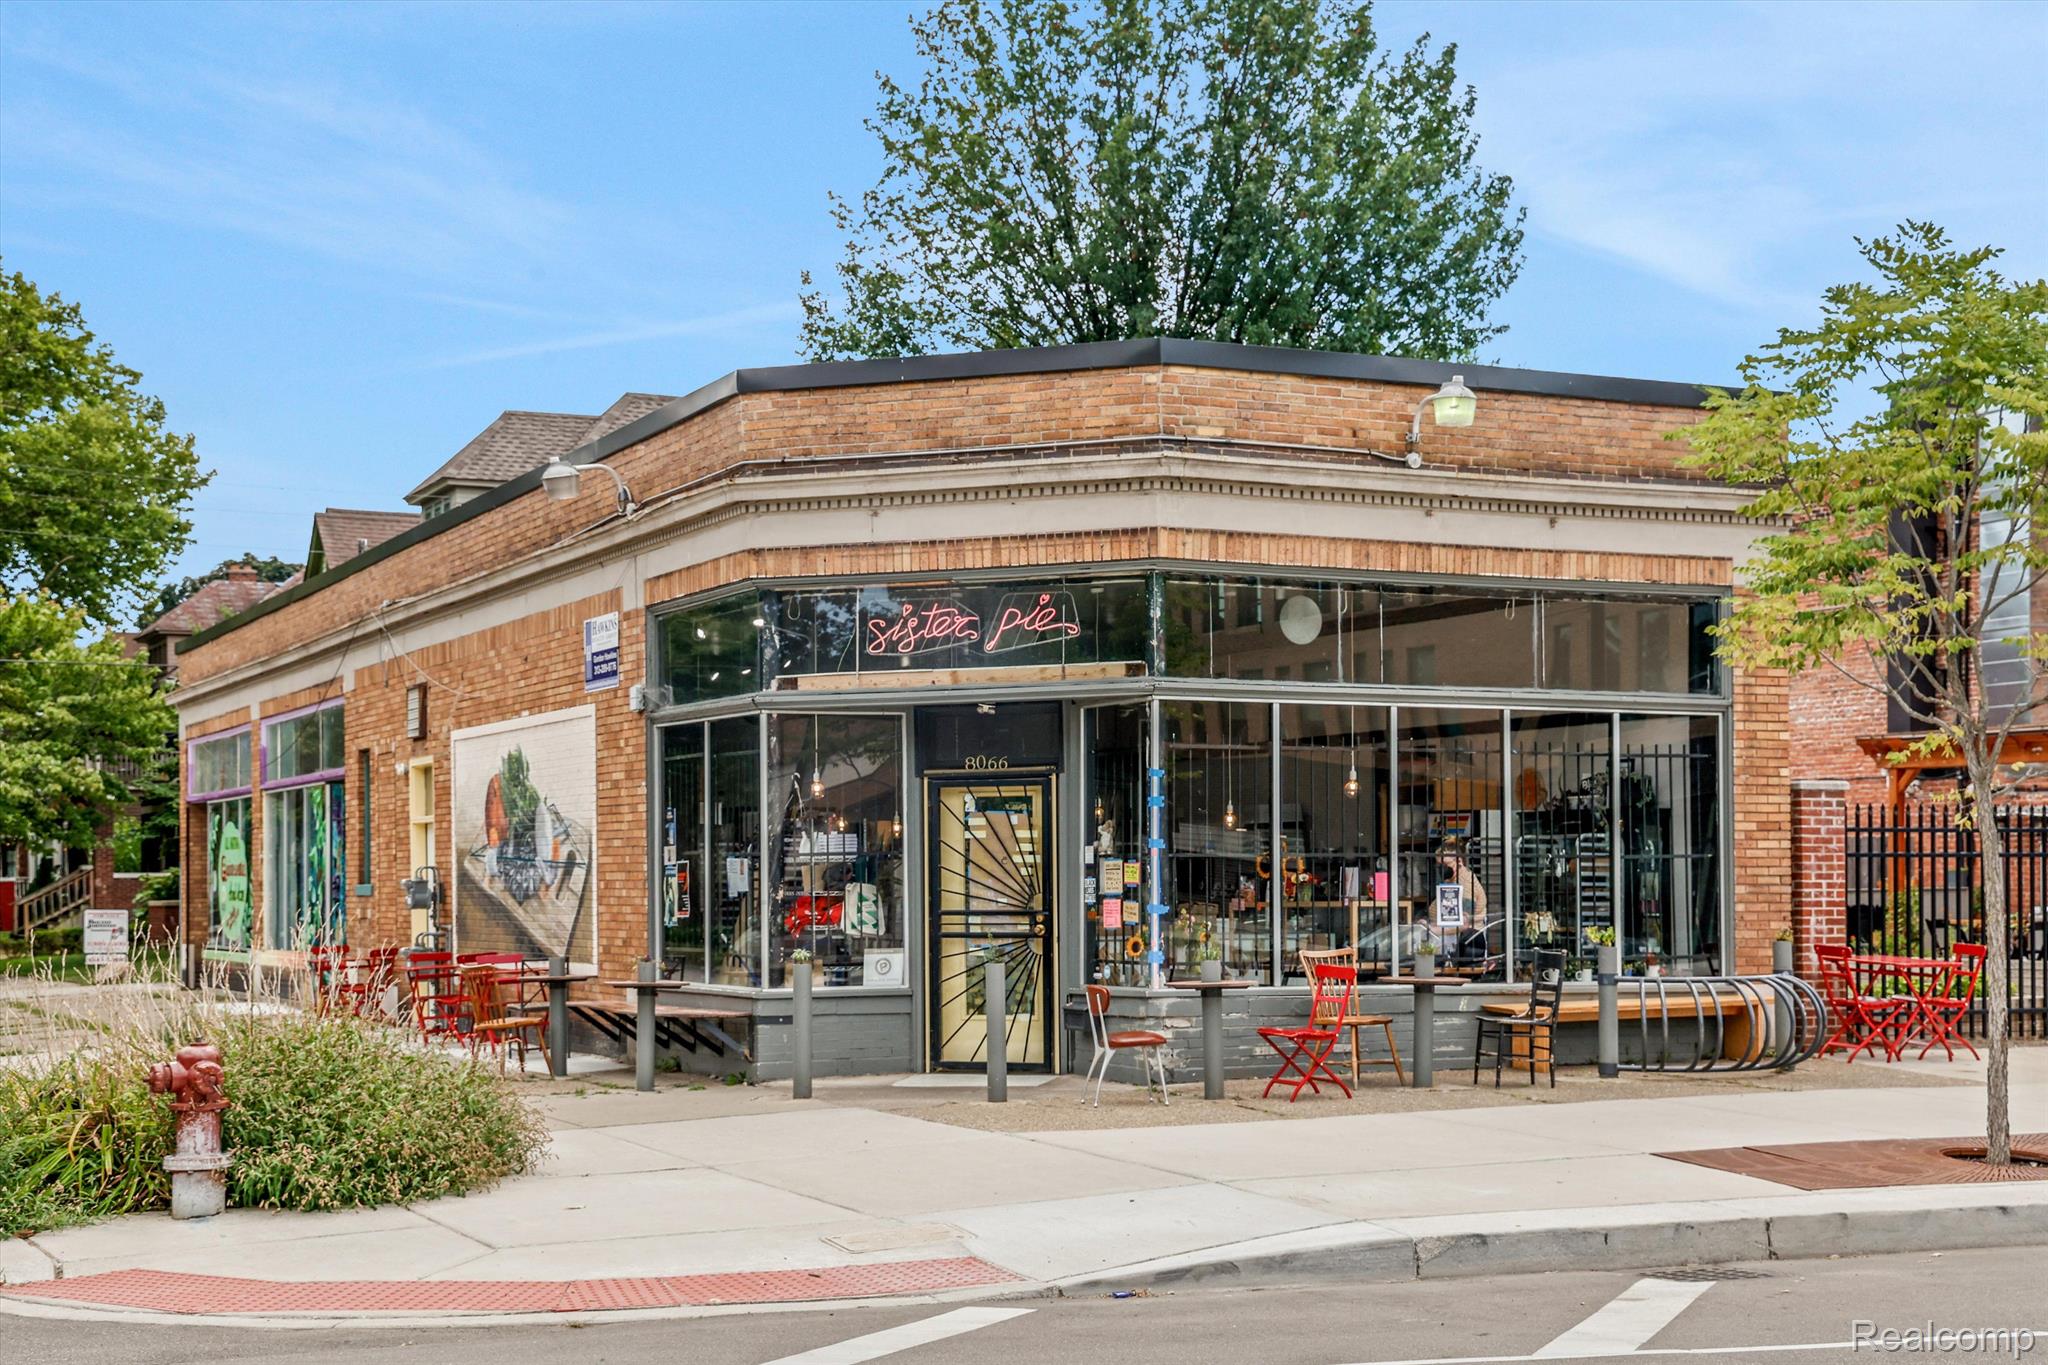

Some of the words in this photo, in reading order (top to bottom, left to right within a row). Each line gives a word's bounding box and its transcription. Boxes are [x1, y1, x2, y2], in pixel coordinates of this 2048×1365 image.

[869, 603, 979, 653] sister
[985, 593, 1079, 651] pie
[965, 754, 1008, 770] 8066
